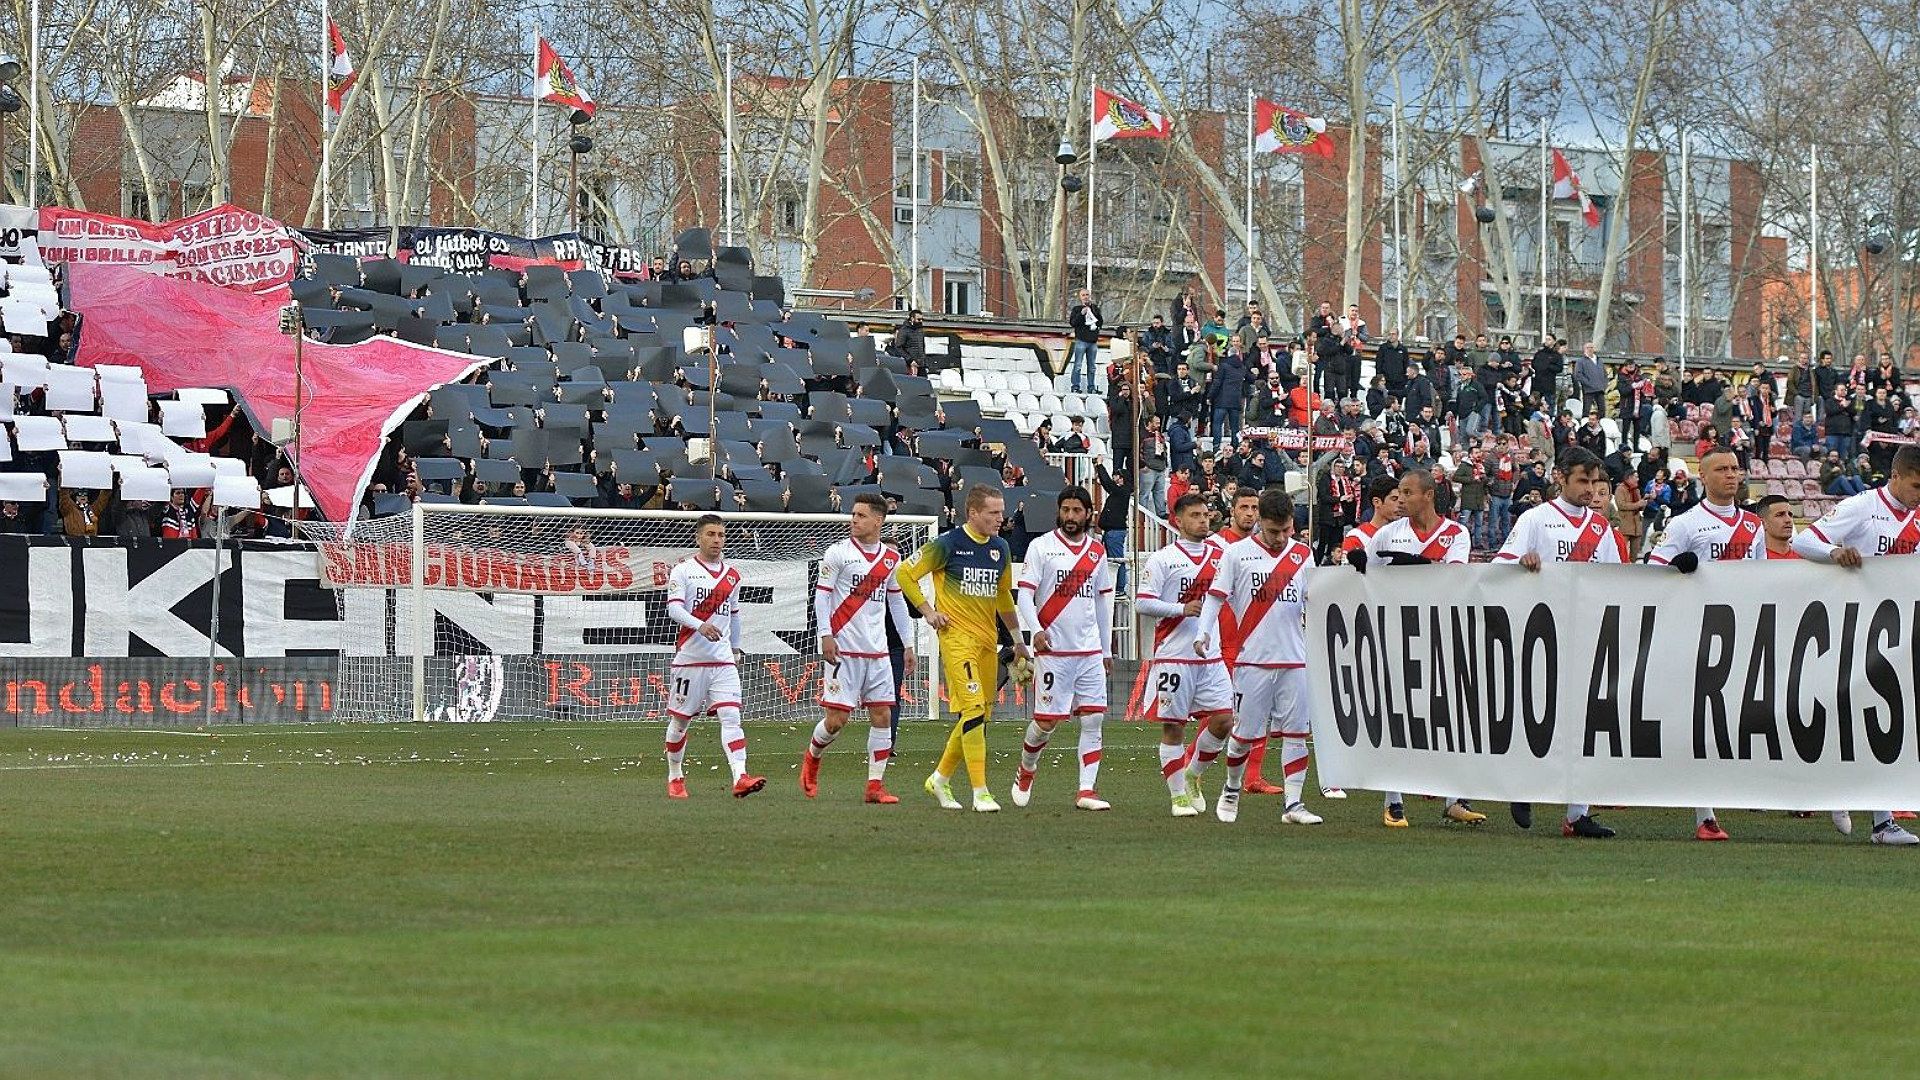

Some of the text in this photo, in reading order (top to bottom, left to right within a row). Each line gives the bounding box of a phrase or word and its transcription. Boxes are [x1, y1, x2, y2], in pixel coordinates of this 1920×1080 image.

[57, 220, 81, 235] UN
[176, 213, 277, 242] UNIDOS
[176, 239, 246, 264] CONTRA
[333, 240, 387, 257] TANTO
[417, 237, 432, 254] el
[489, 237, 510, 253] es
[47, 247, 152, 263] QUE BRILLA
[963, 567, 999, 583] BUFETE
[1180, 577, 1212, 592] BUFET
[1250, 588, 1298, 603] ROSALES
[963, 661, 973, 679] 1
[675, 677, 690, 696] 11
[1043, 672, 1055, 691] 9
[1158, 672, 1181, 693] 29
[1326, 598, 1920, 764] GOLEANDO AL RACIS
